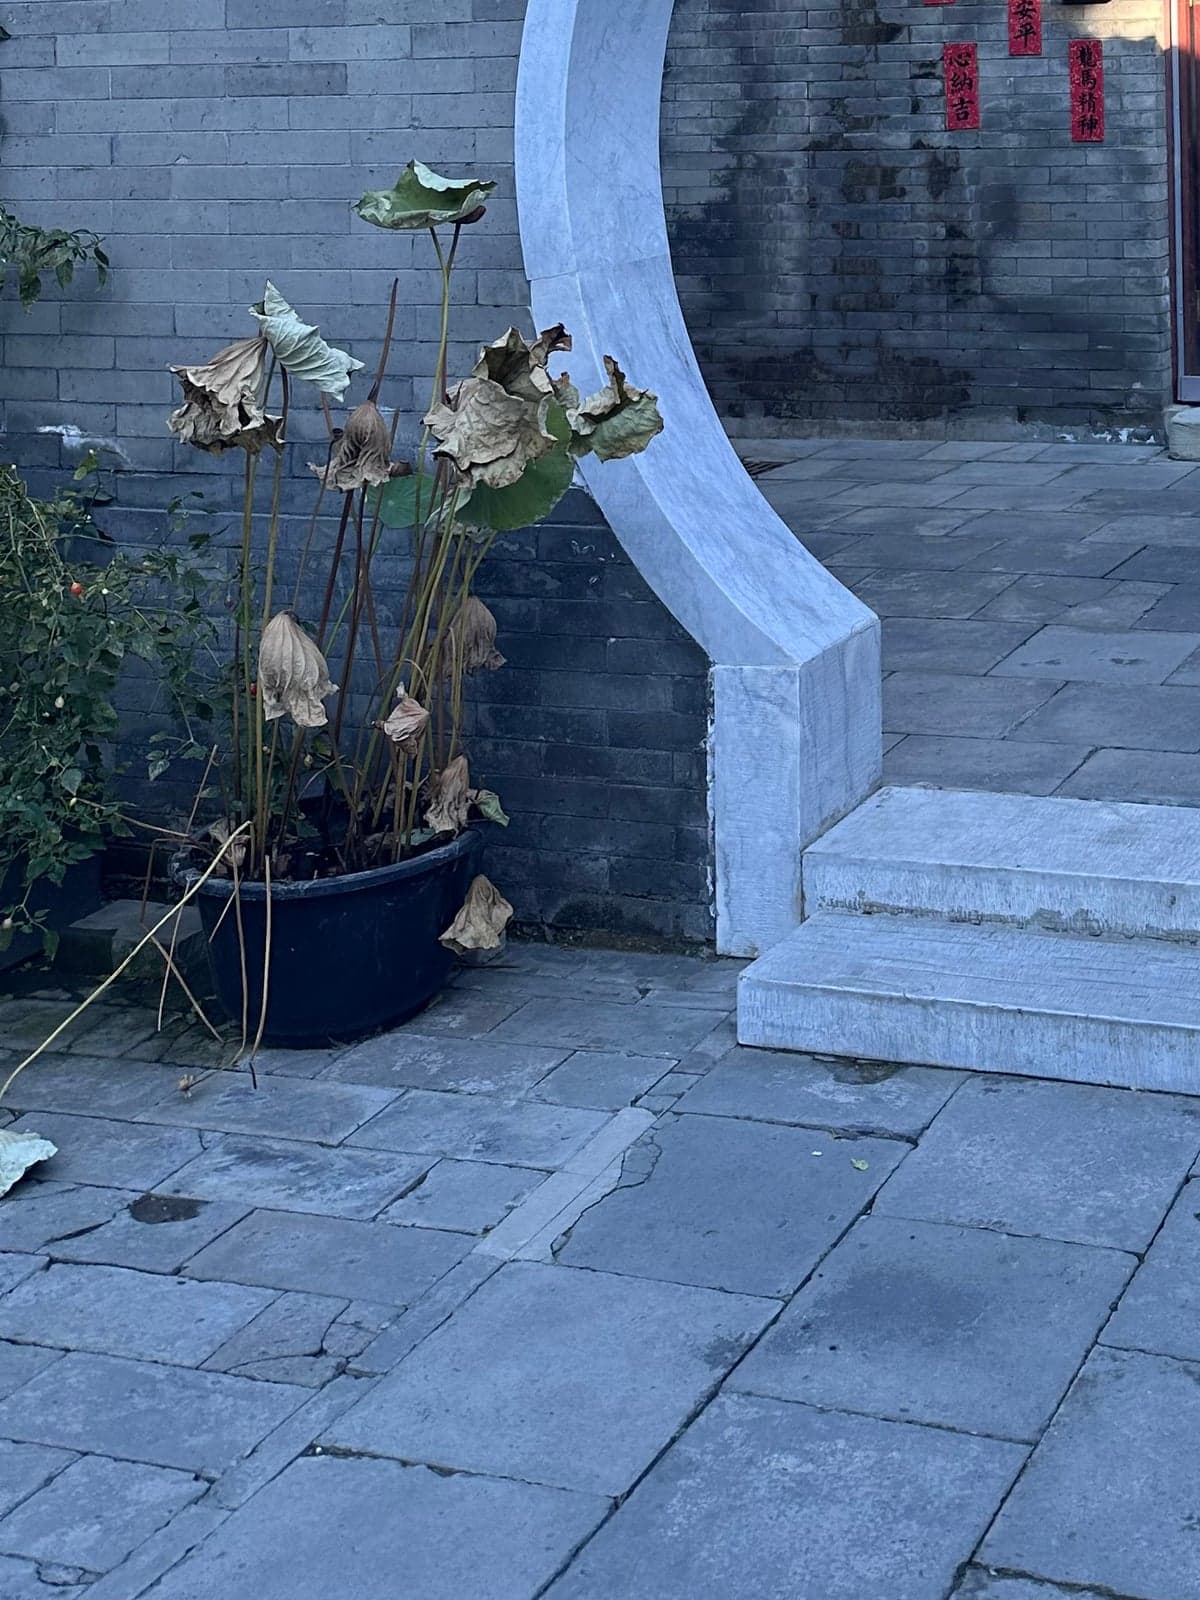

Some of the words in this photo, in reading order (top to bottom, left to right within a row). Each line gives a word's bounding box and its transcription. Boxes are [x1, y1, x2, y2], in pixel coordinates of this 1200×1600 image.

[949, 53, 975, 122] 心納吉
[1077, 45, 1099, 137] 龍馬精神
